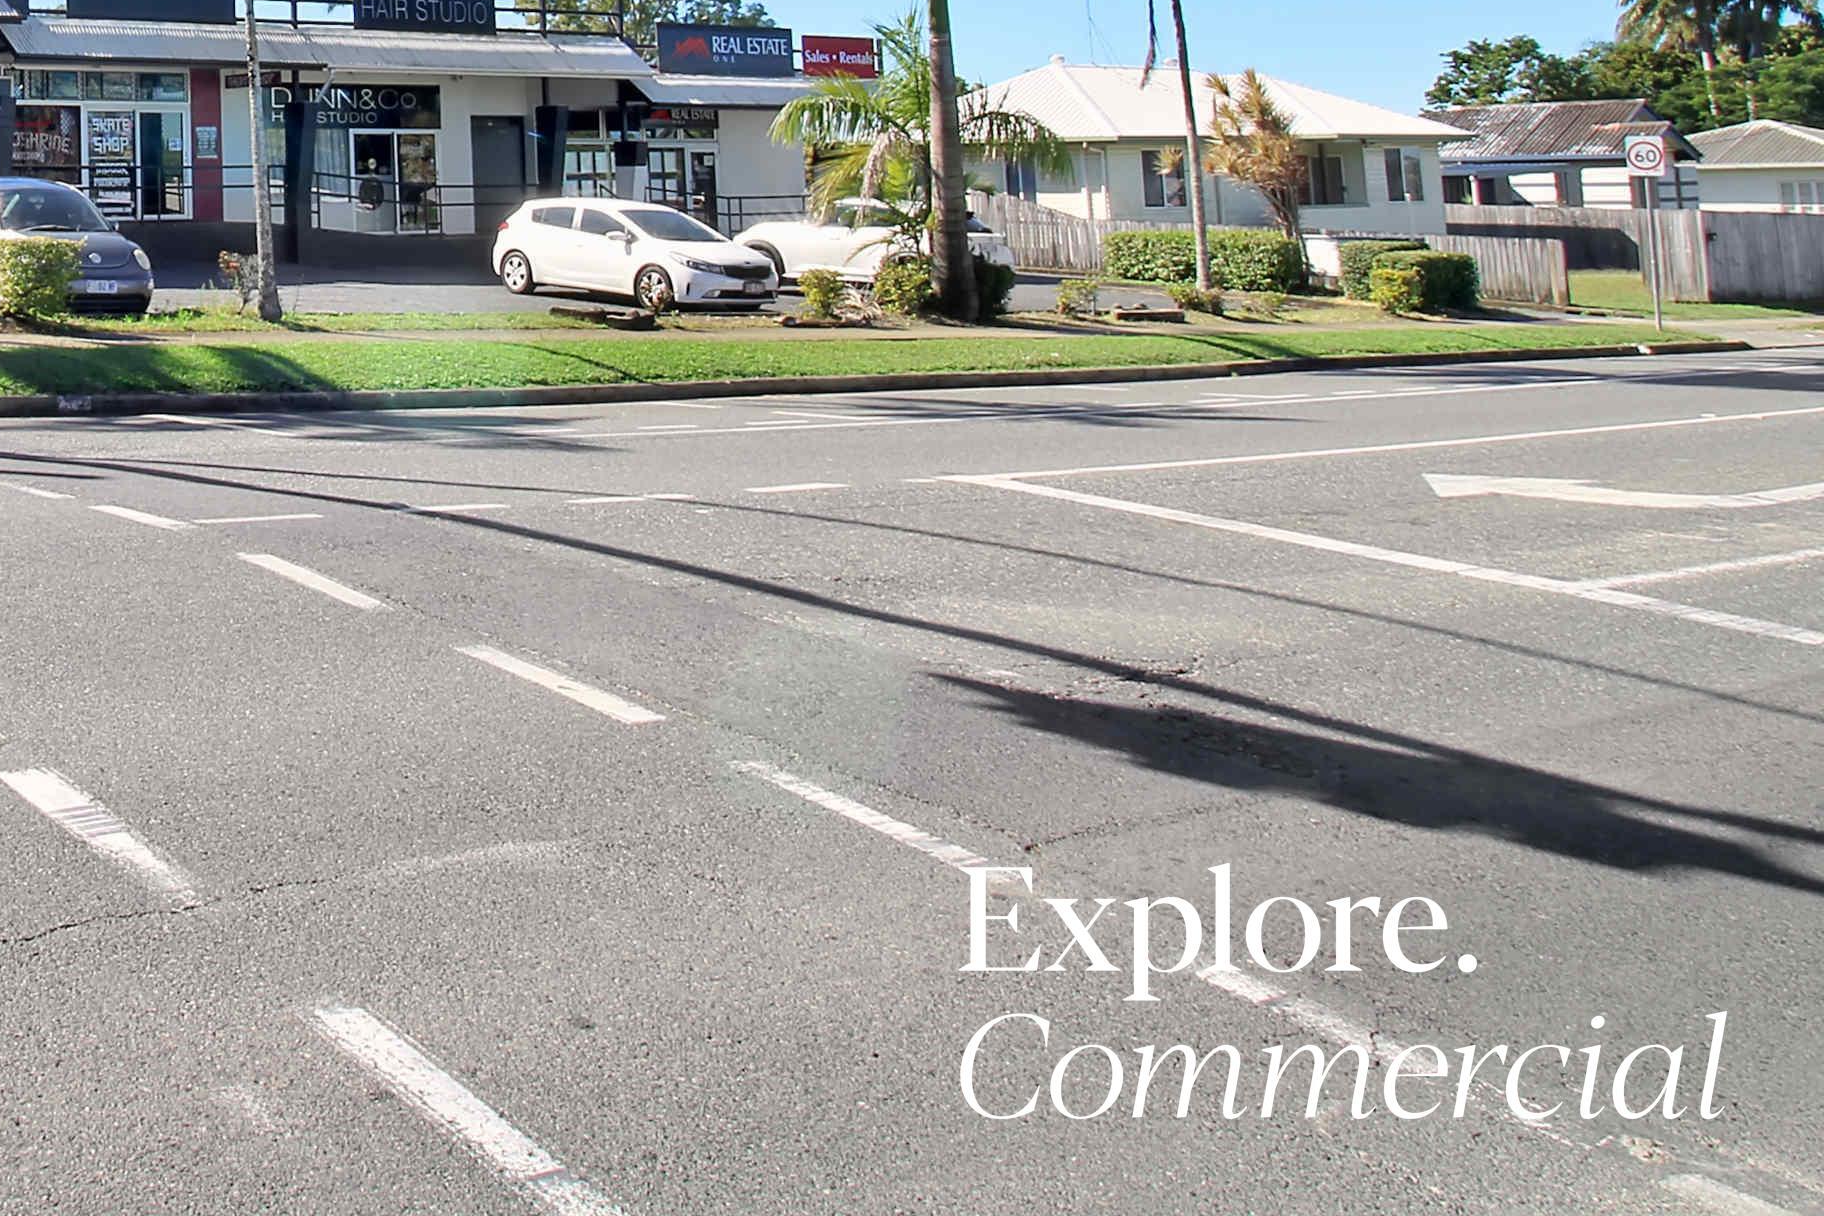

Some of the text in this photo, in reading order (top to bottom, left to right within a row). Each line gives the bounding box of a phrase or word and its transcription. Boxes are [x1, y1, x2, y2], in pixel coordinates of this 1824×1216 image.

[712, 36, 788, 56] REAL ESTATE
[804, 49, 873, 65] Sales Rentals
[92, 117, 131, 133] SKATE
[316, 111, 378, 124] STUDIO
[93, 136, 129, 154] SHOP
[1634, 149, 1657, 162] 60
